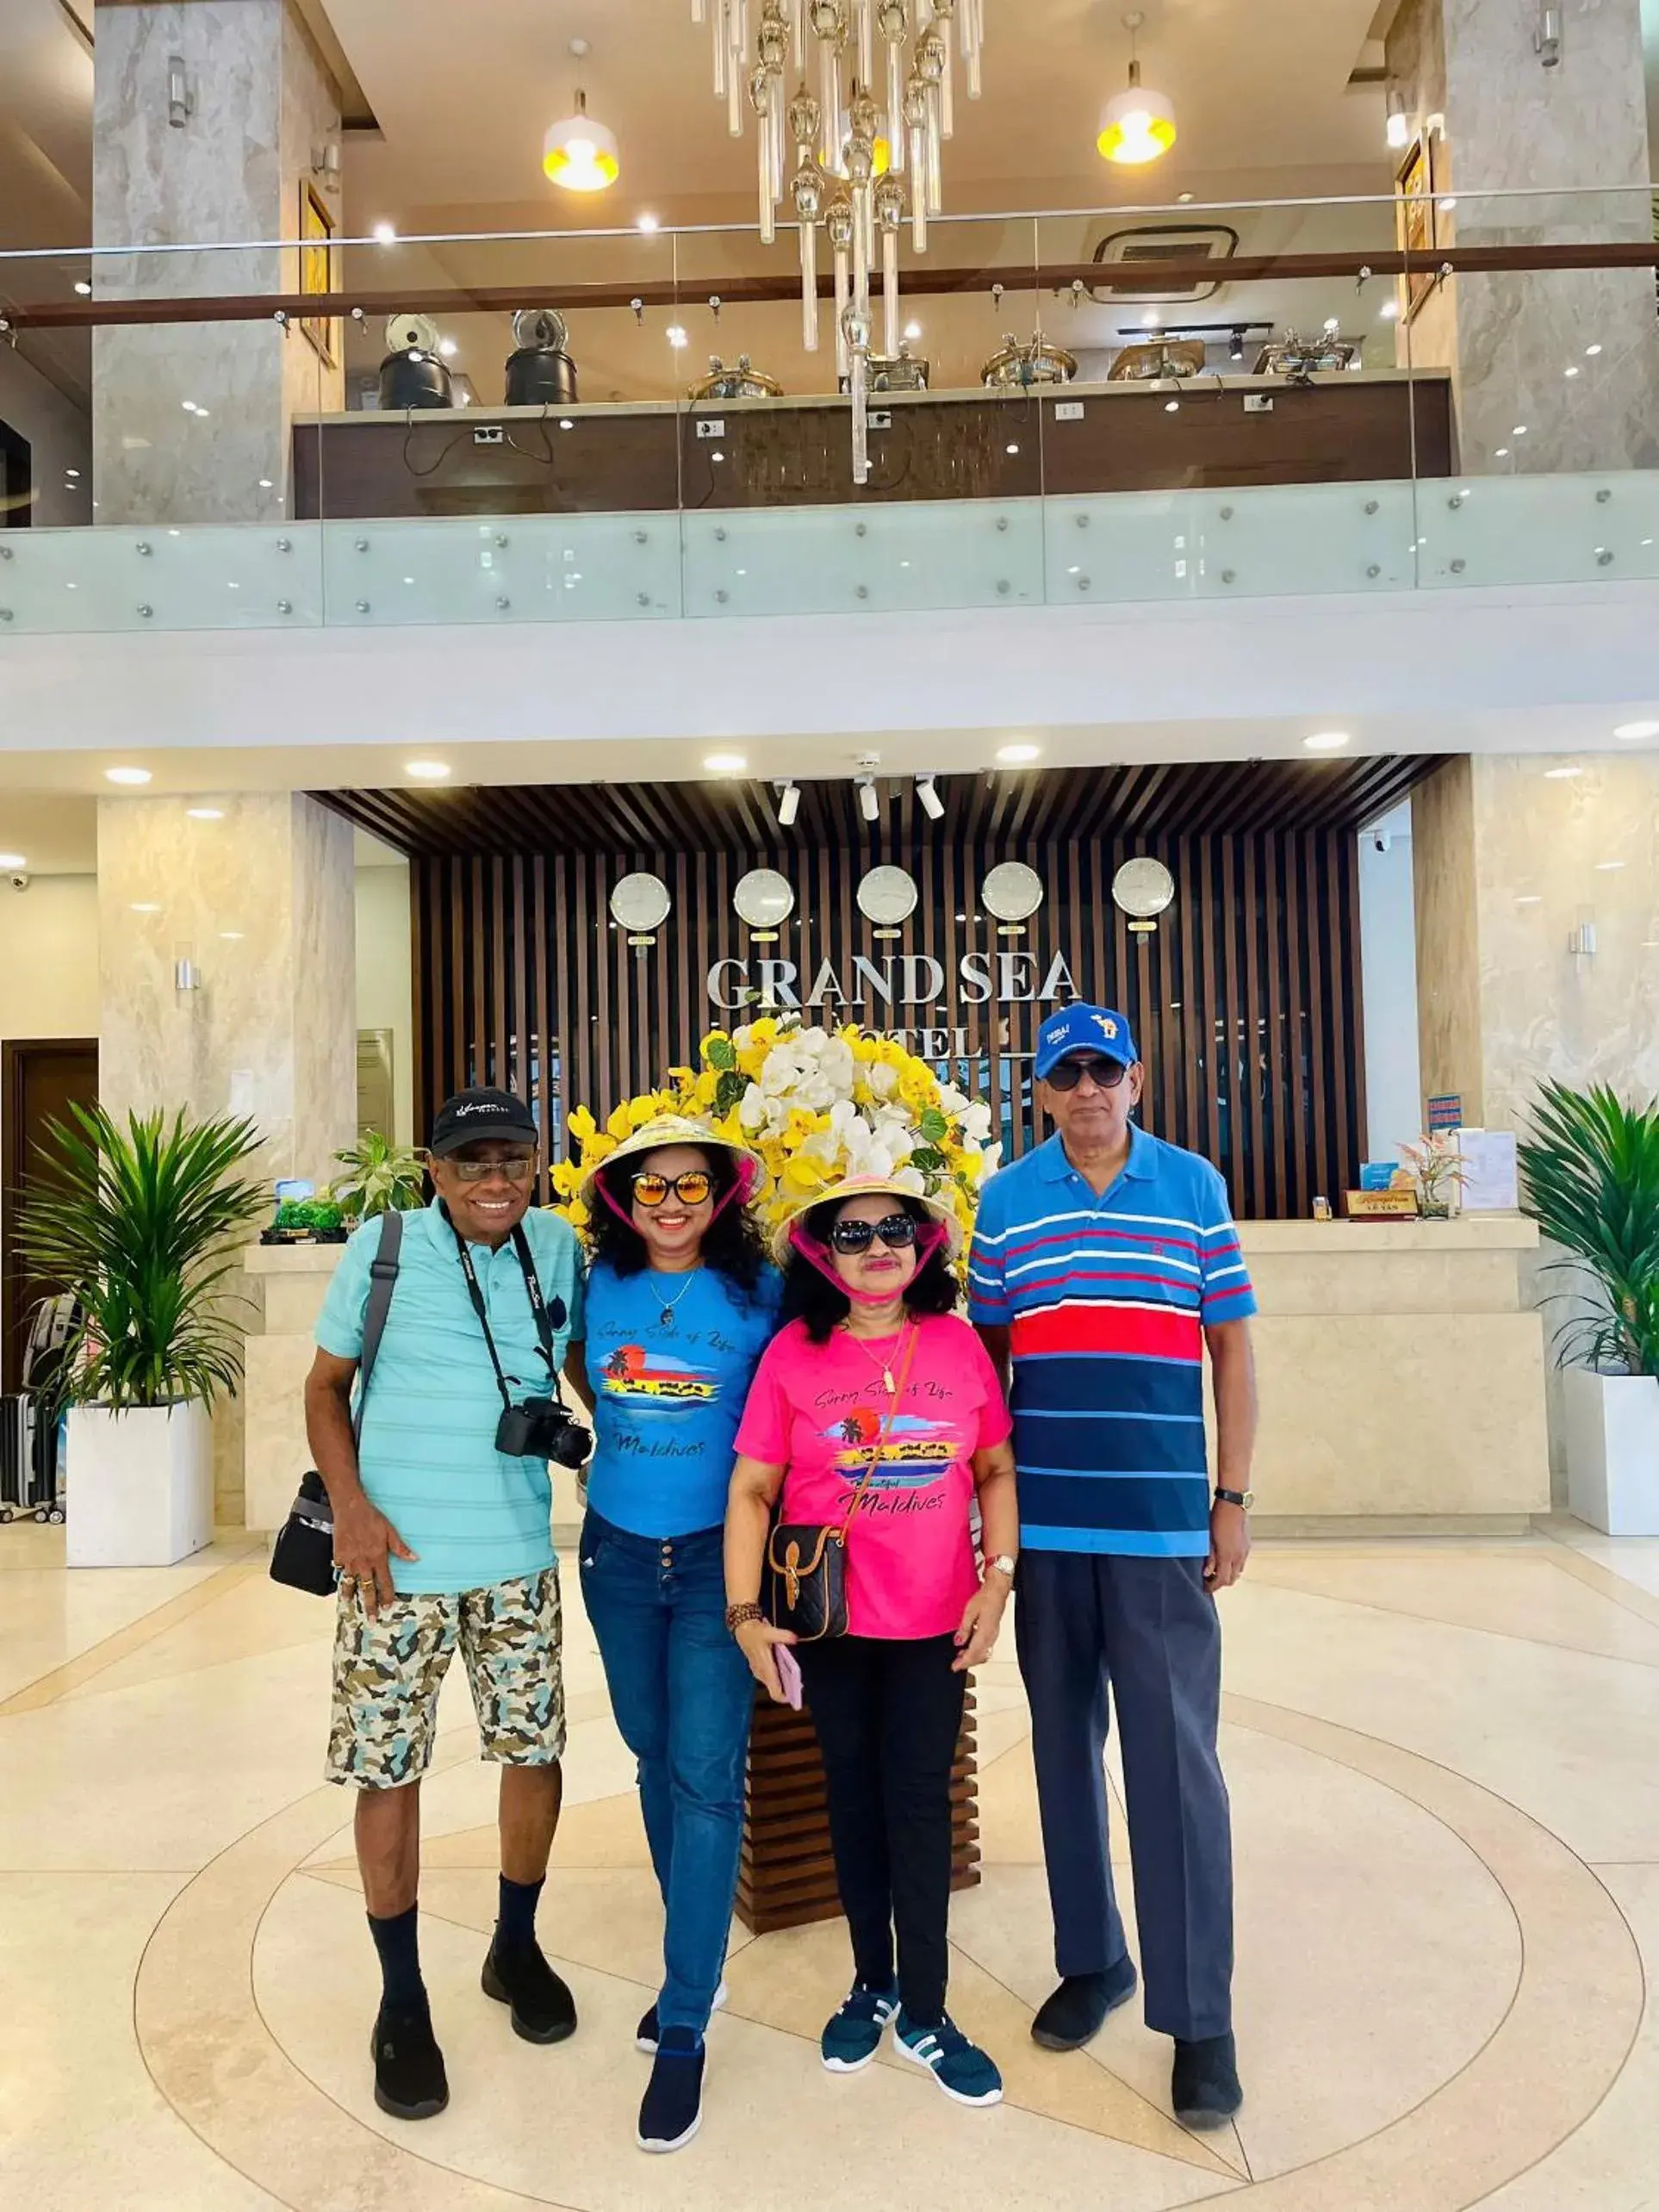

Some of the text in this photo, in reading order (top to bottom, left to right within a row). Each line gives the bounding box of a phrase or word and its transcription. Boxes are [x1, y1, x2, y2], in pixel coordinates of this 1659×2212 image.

[705, 950, 1084, 1009] GRAND SEA
[837, 1488, 947, 1517] Maldives
